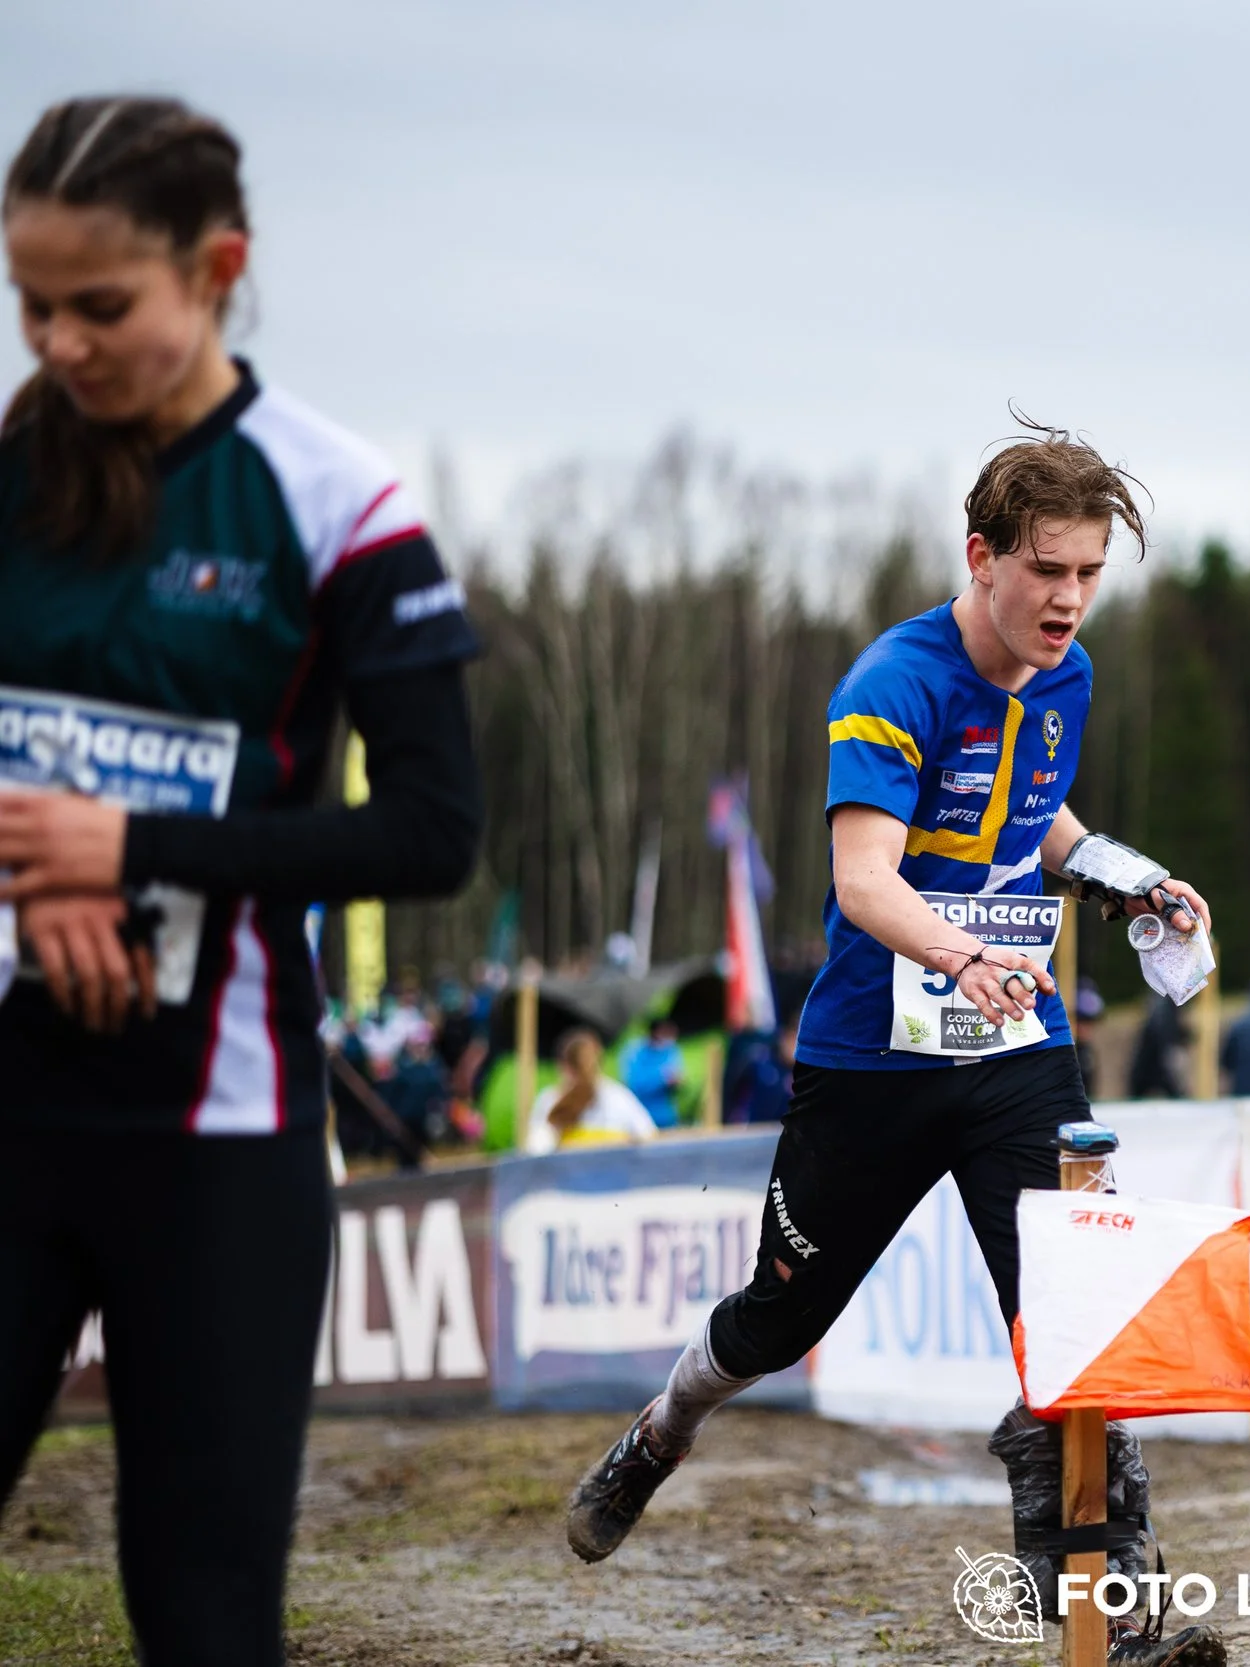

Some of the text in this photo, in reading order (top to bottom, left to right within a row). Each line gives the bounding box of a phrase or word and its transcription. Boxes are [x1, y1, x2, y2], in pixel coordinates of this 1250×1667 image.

[973, 933, 996, 942] DELN
[1024, 935, 1042, 944] 2026
[946, 1013, 990, 1024] GODKÄ
[770, 1178, 820, 1260] TRIMTEX
